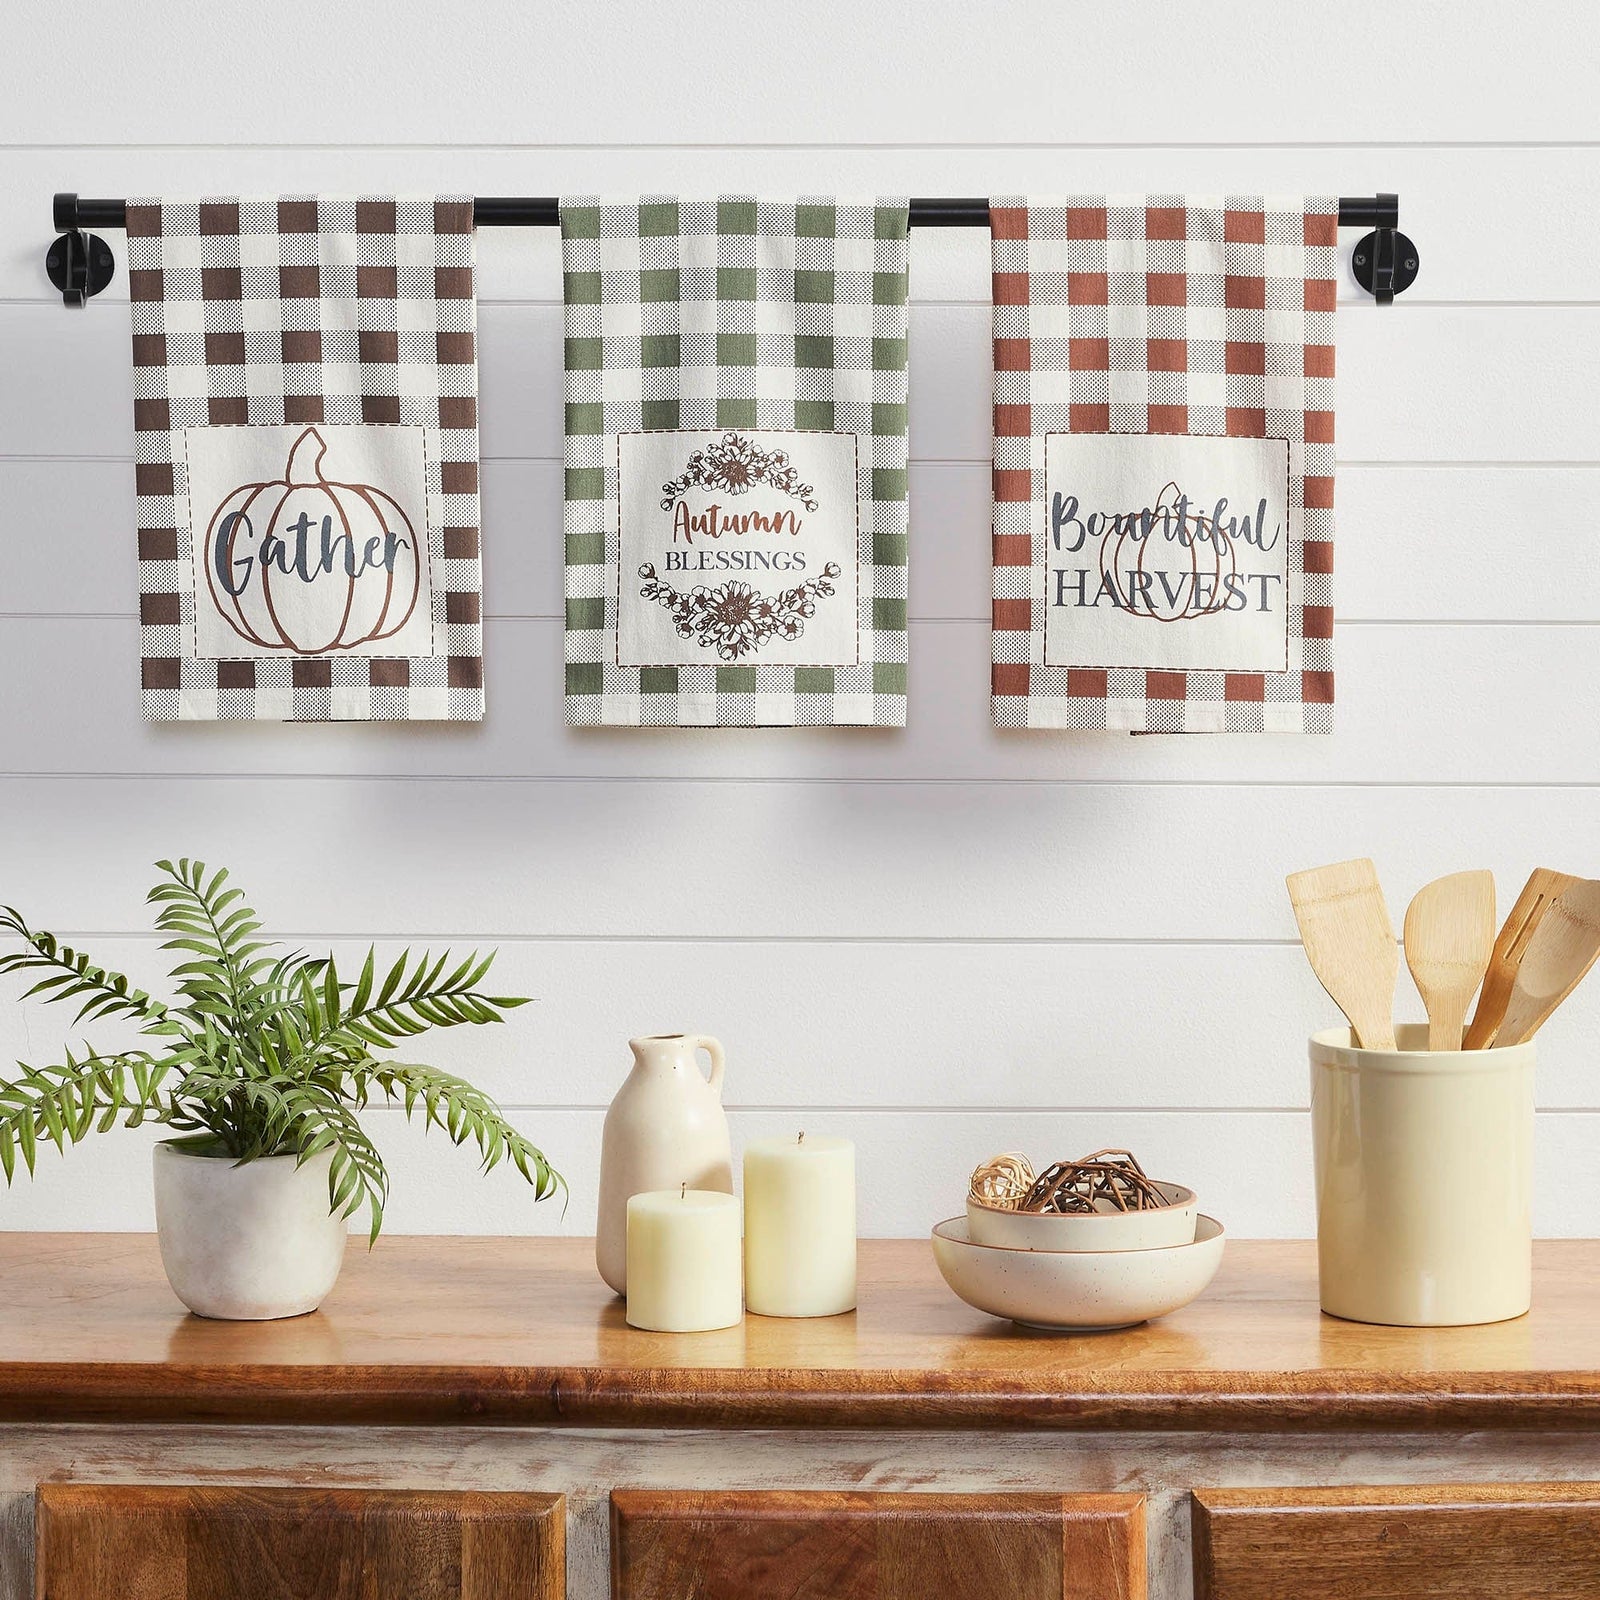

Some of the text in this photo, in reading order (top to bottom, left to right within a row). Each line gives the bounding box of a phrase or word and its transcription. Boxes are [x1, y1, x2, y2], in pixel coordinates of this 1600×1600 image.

[673, 500, 802, 545] Autumn
[1052, 491, 1280, 557] Bountiful
[215, 511, 410, 596] Gather
[665, 551, 806, 571] BLESSINGS
[1052, 569, 1281, 612] HARVEST
